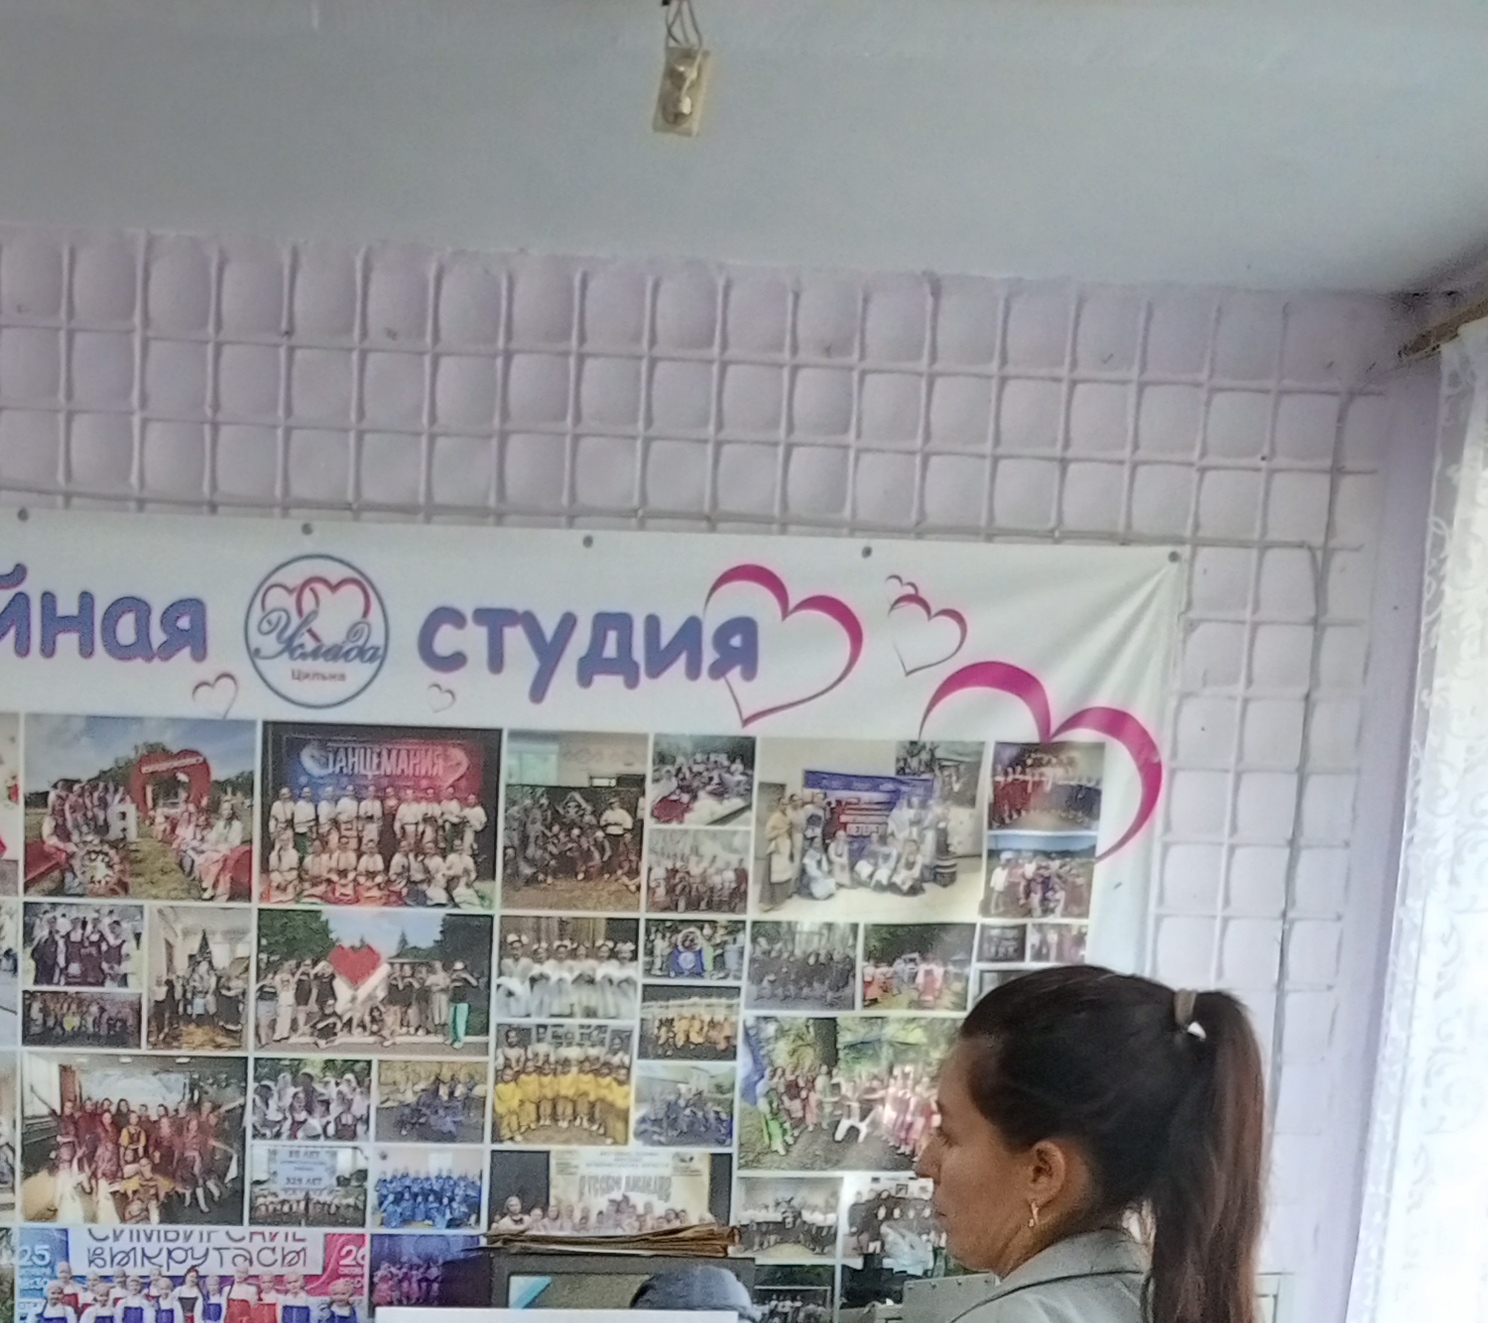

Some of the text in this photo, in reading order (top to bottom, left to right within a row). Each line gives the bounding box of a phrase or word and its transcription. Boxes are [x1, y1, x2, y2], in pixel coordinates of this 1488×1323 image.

[254, 607, 383, 664] Услада
[417, 605, 759, 705] студия
[291, 669, 347, 682] Цильна
